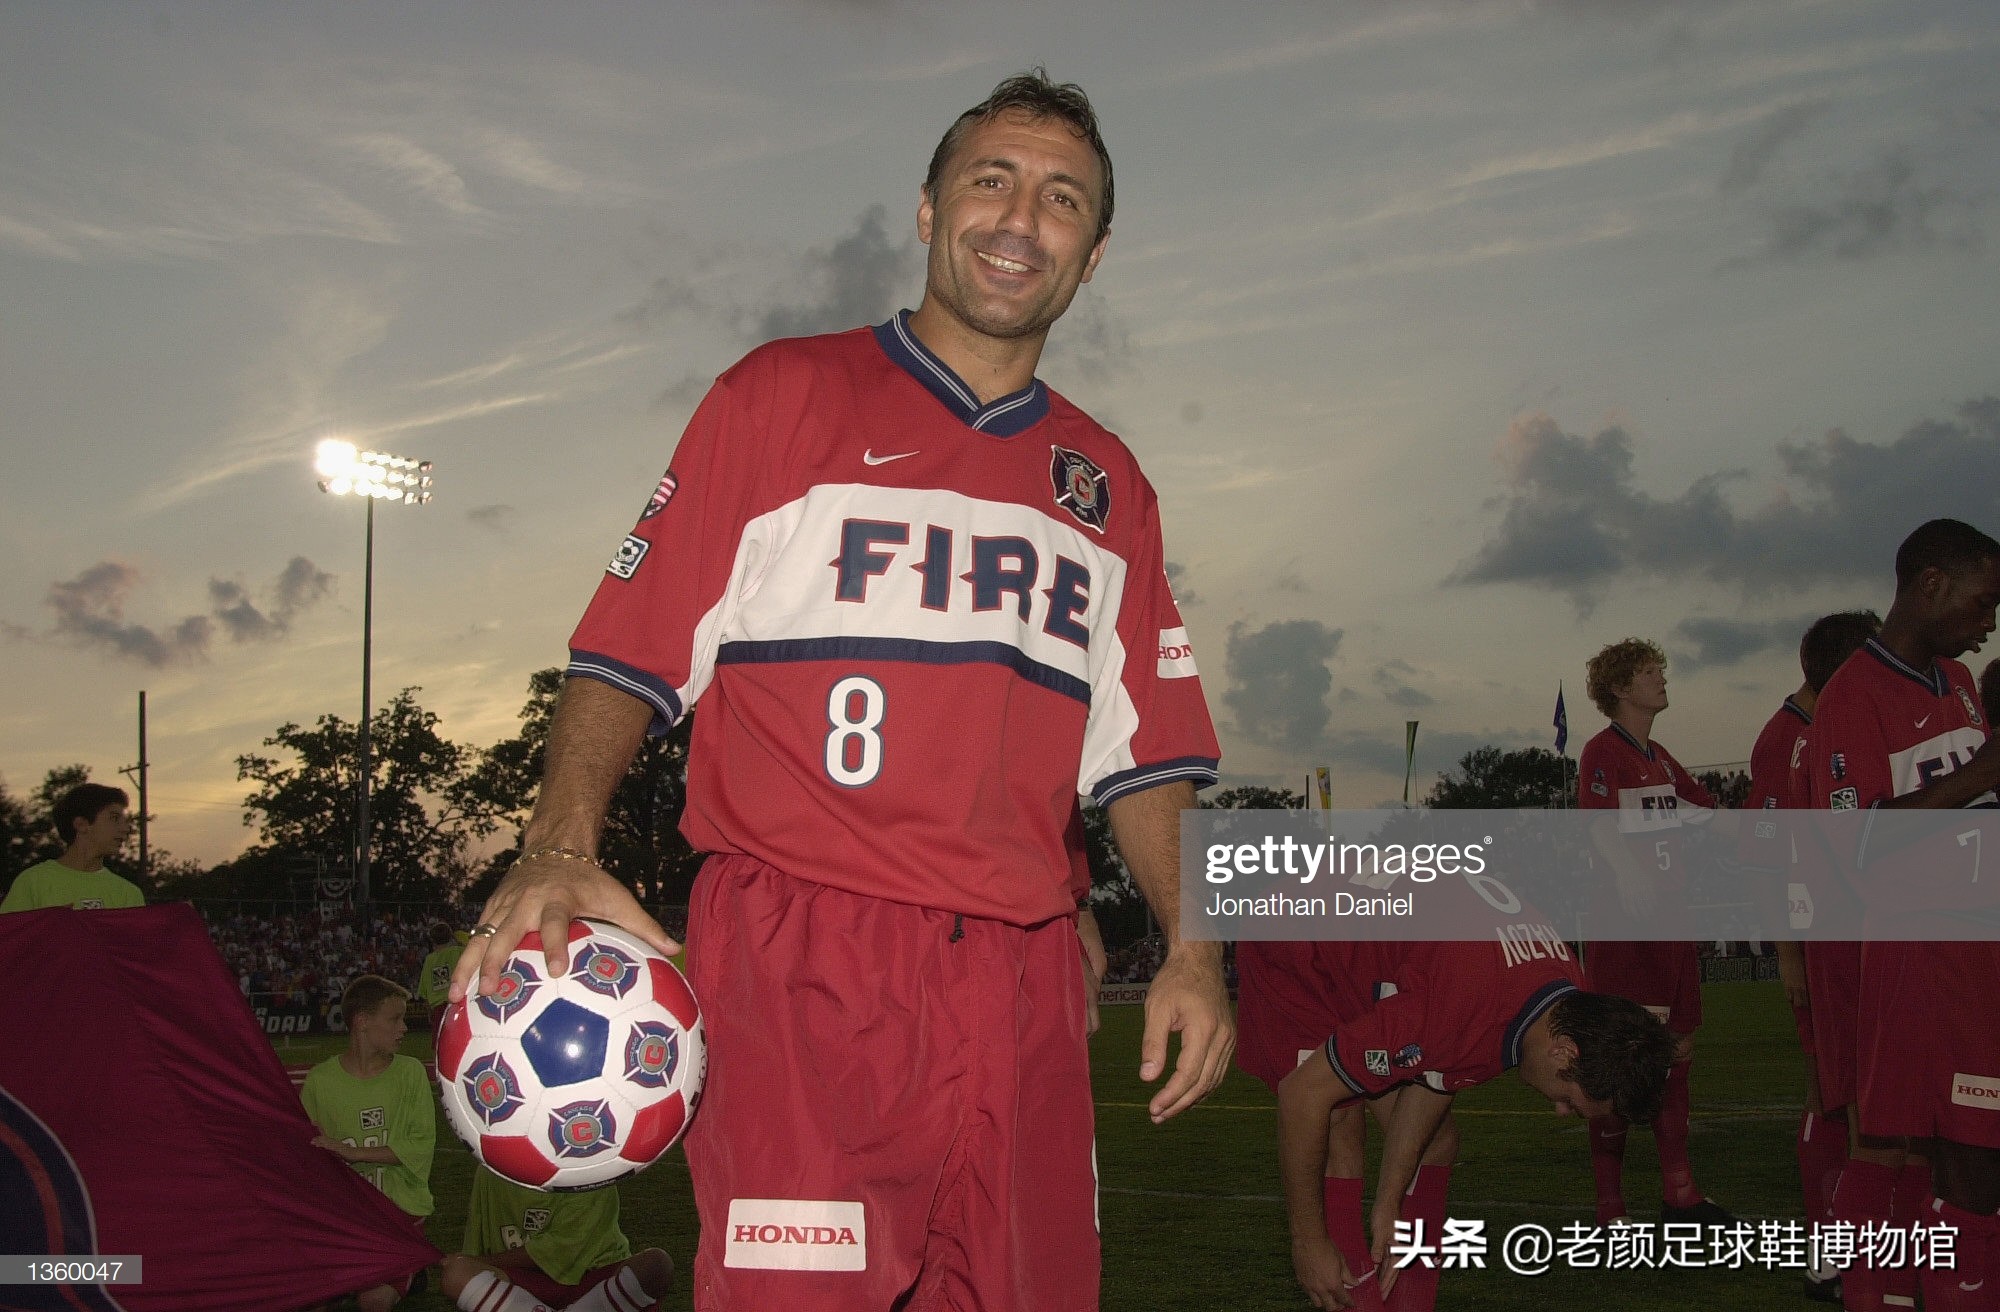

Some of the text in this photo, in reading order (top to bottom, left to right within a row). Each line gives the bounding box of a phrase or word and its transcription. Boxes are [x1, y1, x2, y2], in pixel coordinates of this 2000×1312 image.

[830, 517, 1090, 651] FIRE
[823, 673, 885, 787] 8
[1656, 841, 1670, 870] 5
[1957, 829, 1981, 883] 7
[1496, 922, 1571, 968] RAZOV
[572, 1122, 593, 1142] C
[733, 1224, 858, 1246] HONDA
